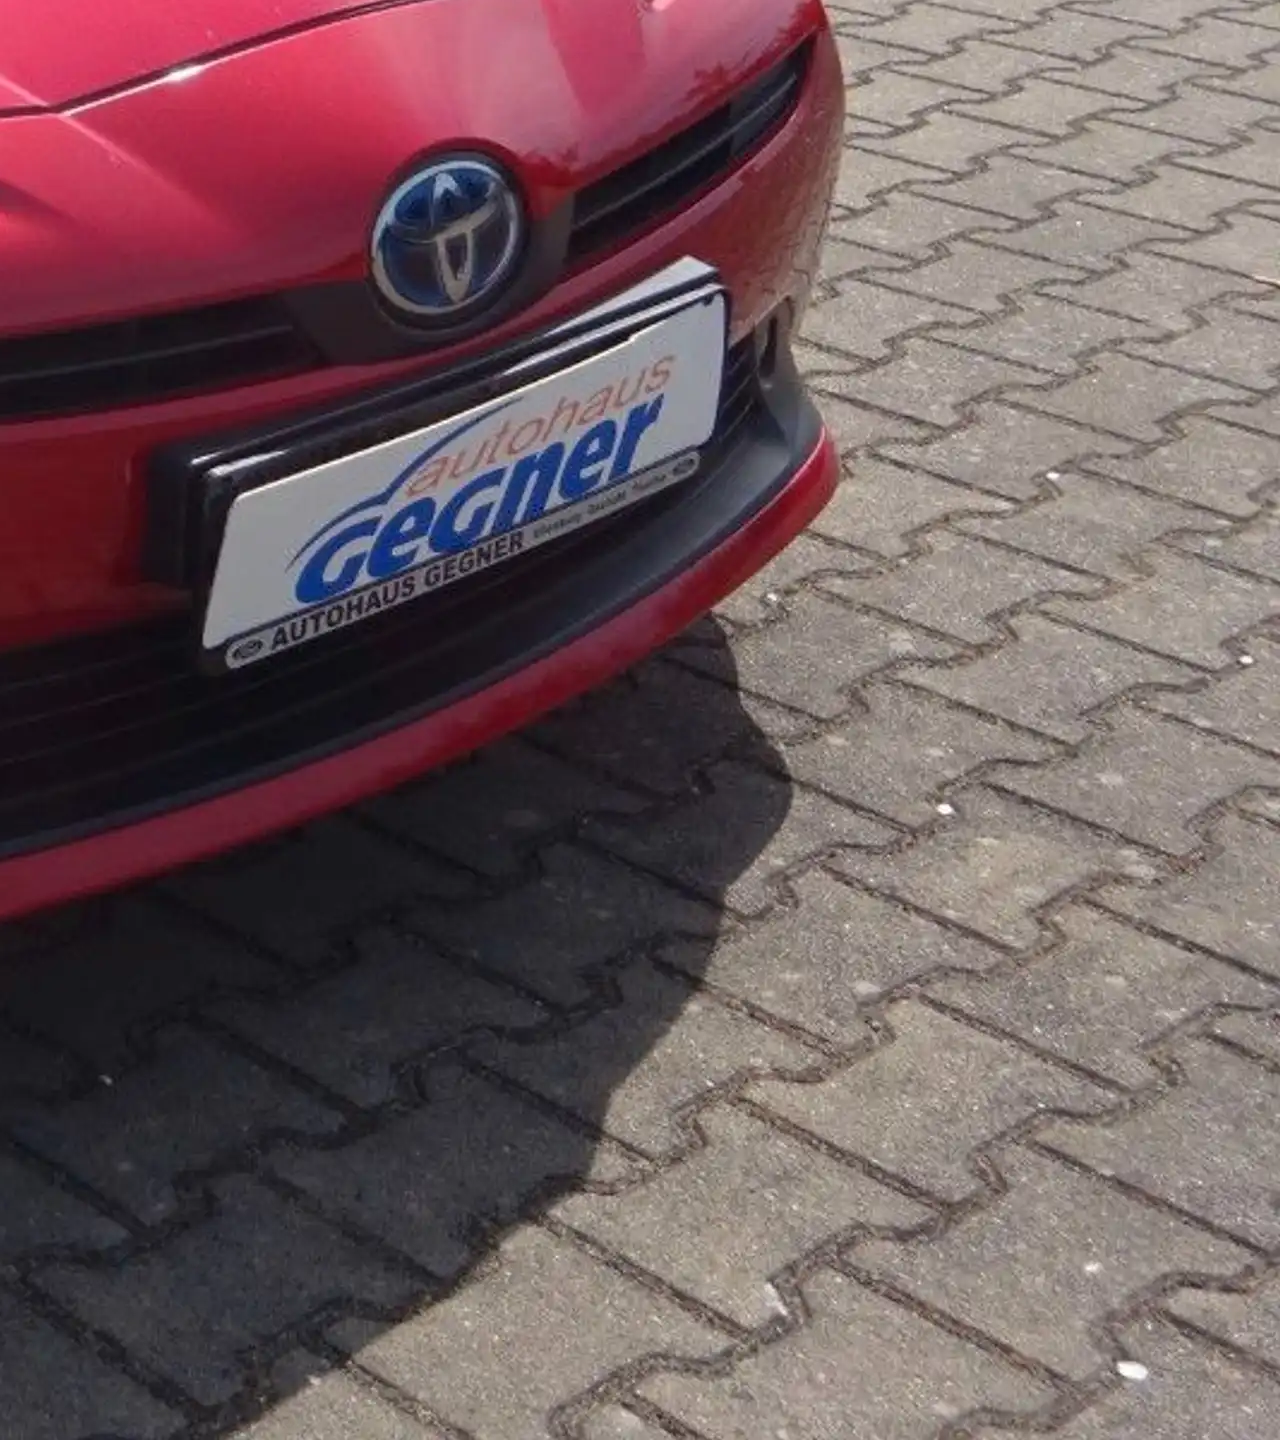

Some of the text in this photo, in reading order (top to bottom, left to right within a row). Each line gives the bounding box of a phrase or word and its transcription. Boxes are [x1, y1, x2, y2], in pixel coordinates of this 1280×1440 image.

[405, 356, 675, 498] autohaus
[271, 530, 524, 650] AUTOHAUS GEGNER
